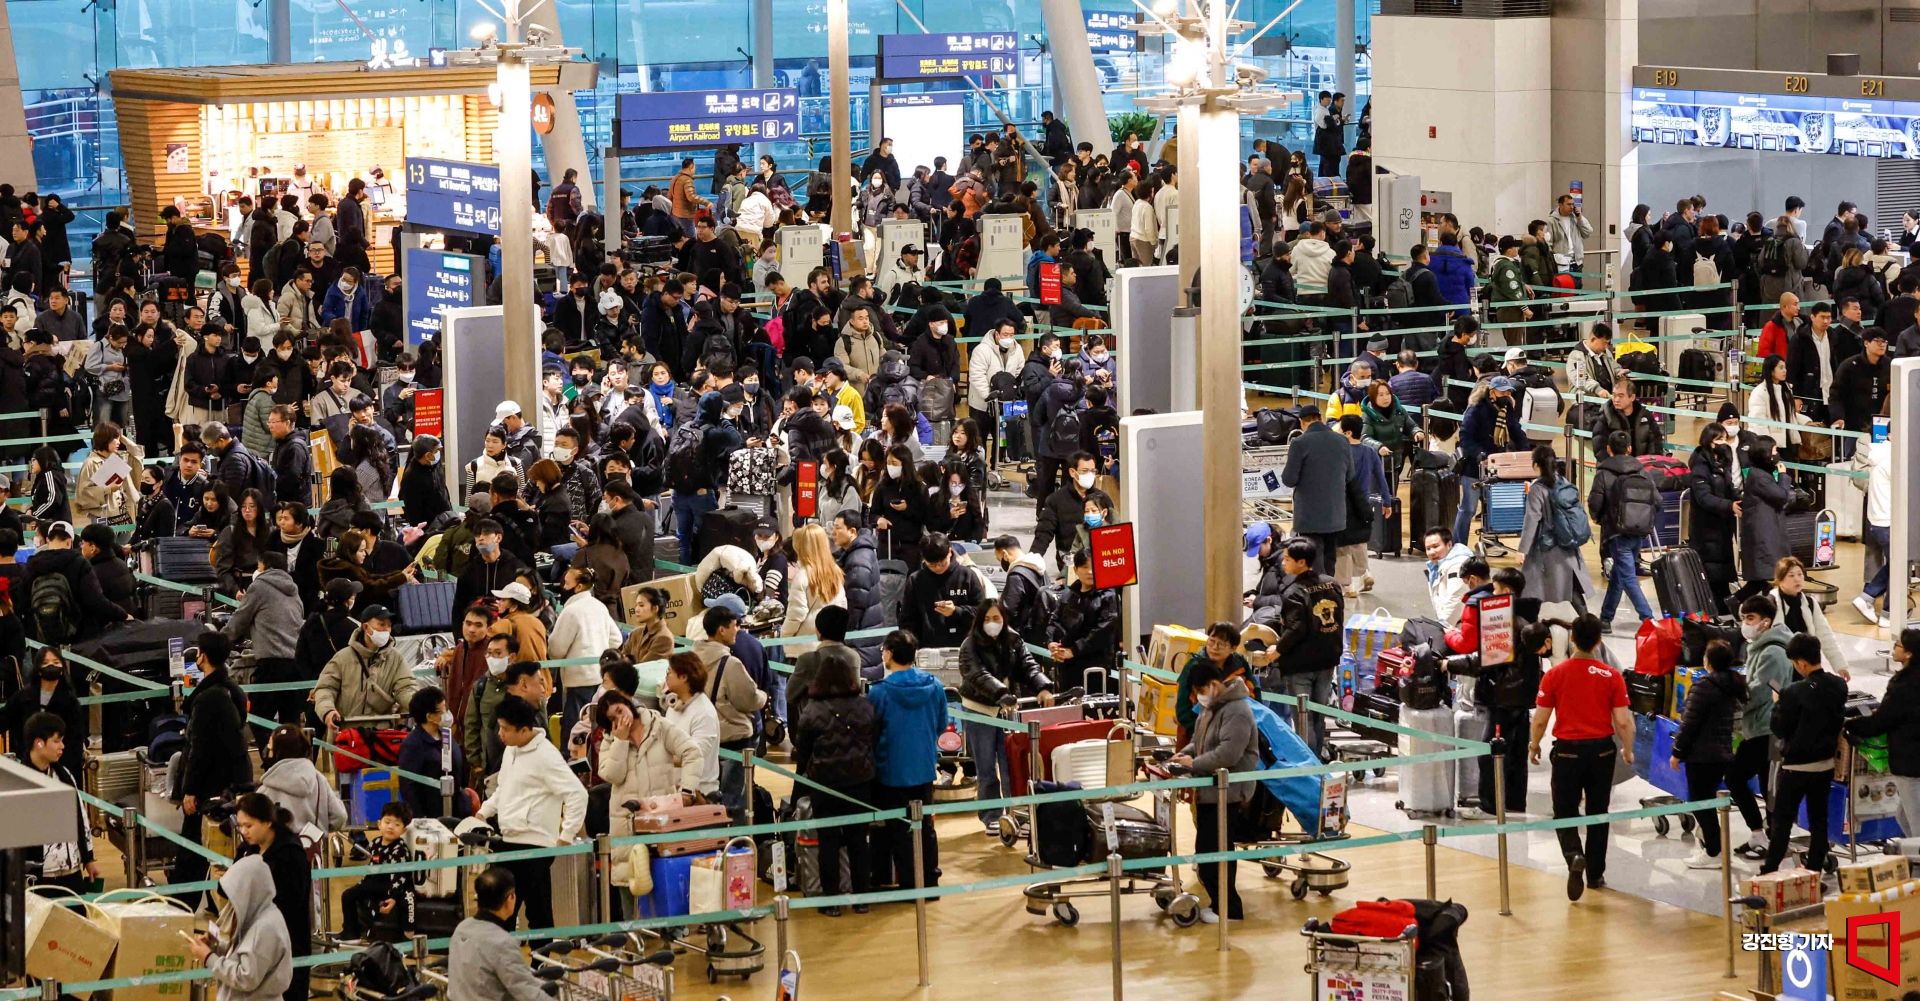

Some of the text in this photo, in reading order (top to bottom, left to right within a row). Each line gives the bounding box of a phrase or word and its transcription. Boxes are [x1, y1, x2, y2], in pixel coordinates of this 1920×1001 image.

[1655, 70, 1678, 87] E19
[1785, 76, 1809, 93] E20
[1861, 80, 1885, 97] E21
[708, 104, 738, 114] Arrivals
[741, 97, 760, 109] 도착
[724, 123, 760, 136] 공항철도
[669, 131, 721, 143] Airport Railroad
[409, 163, 425, 185] 1-3
[474, 209, 487, 224] 도착
[1102, 557, 1126, 568] 하노이
